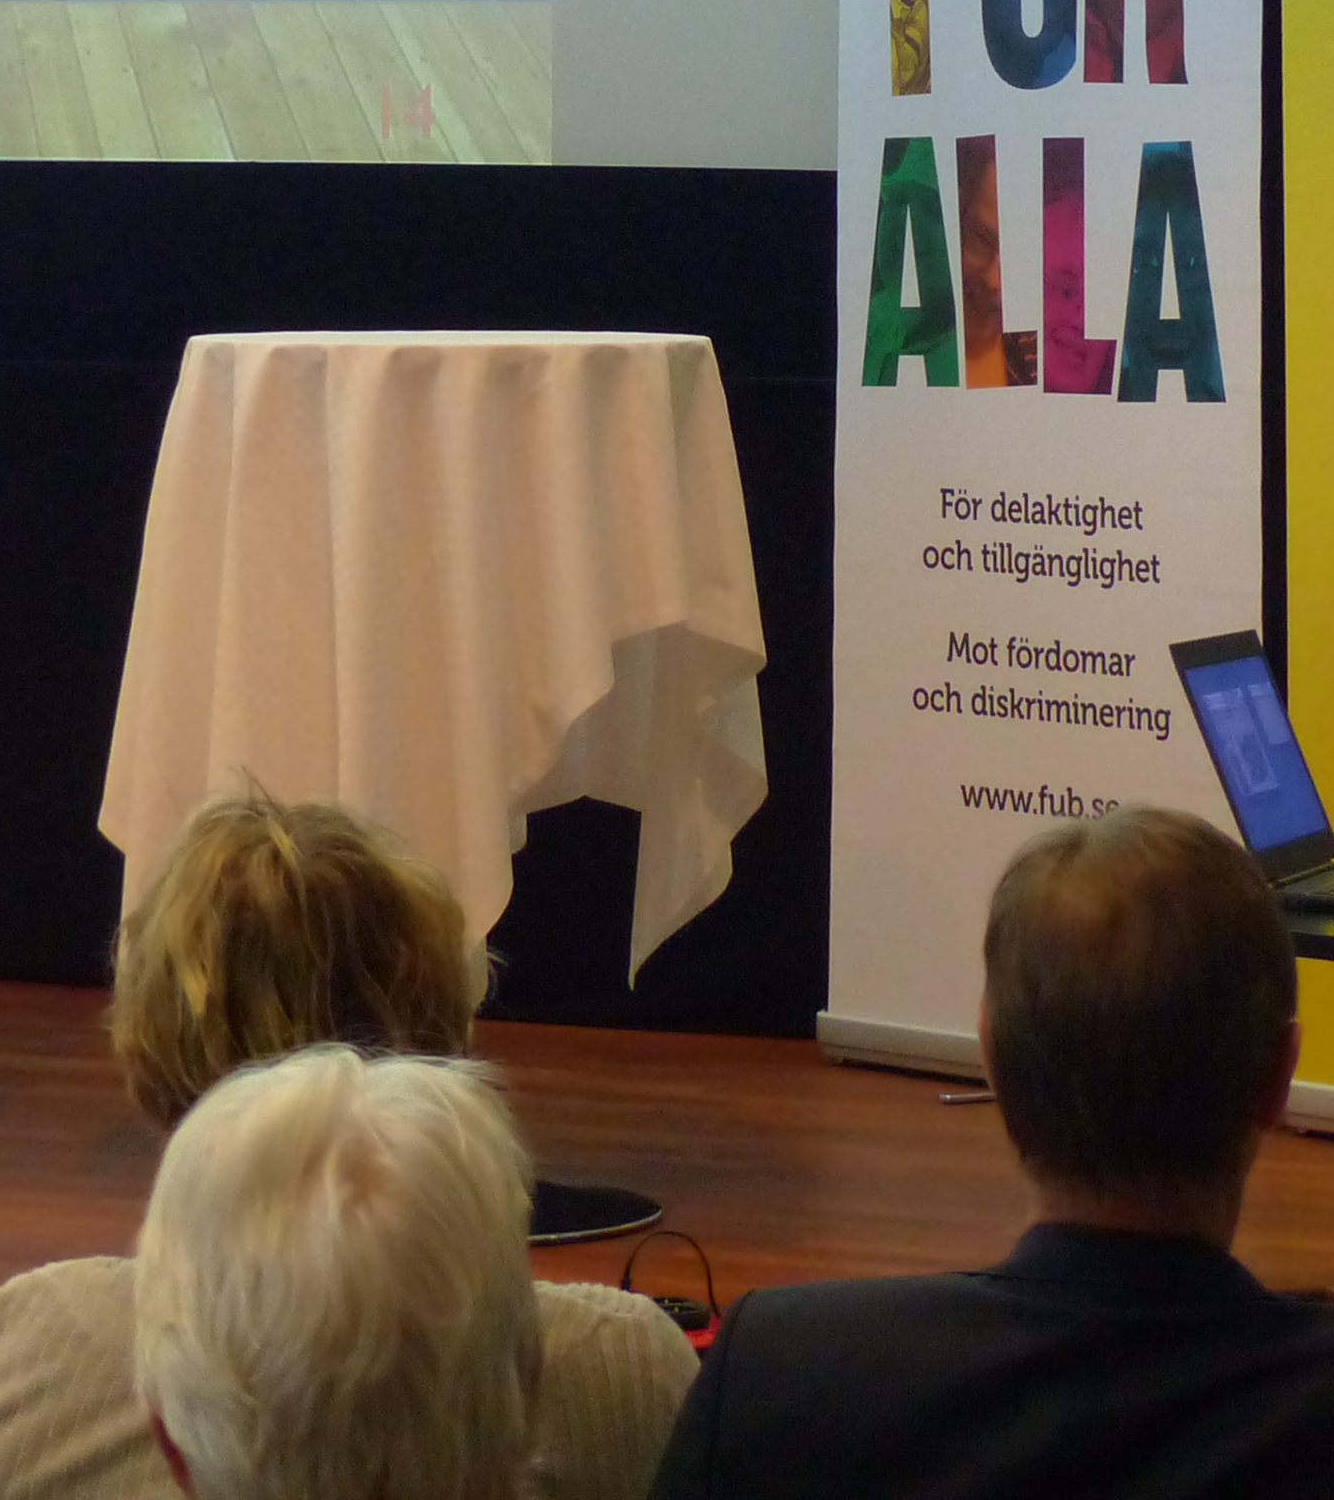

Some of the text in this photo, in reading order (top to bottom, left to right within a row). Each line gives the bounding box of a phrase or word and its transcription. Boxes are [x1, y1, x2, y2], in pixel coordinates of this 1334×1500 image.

[382, 83, 434, 138] 14
[862, 135, 1226, 403] ALLA
[940, 488, 1143, 536] För delaktighet
[923, 540, 1160, 589] och tillgänglighet
[947, 632, 1135, 676] Mot fördomar
[913, 682, 1171, 741] och diskriminering
